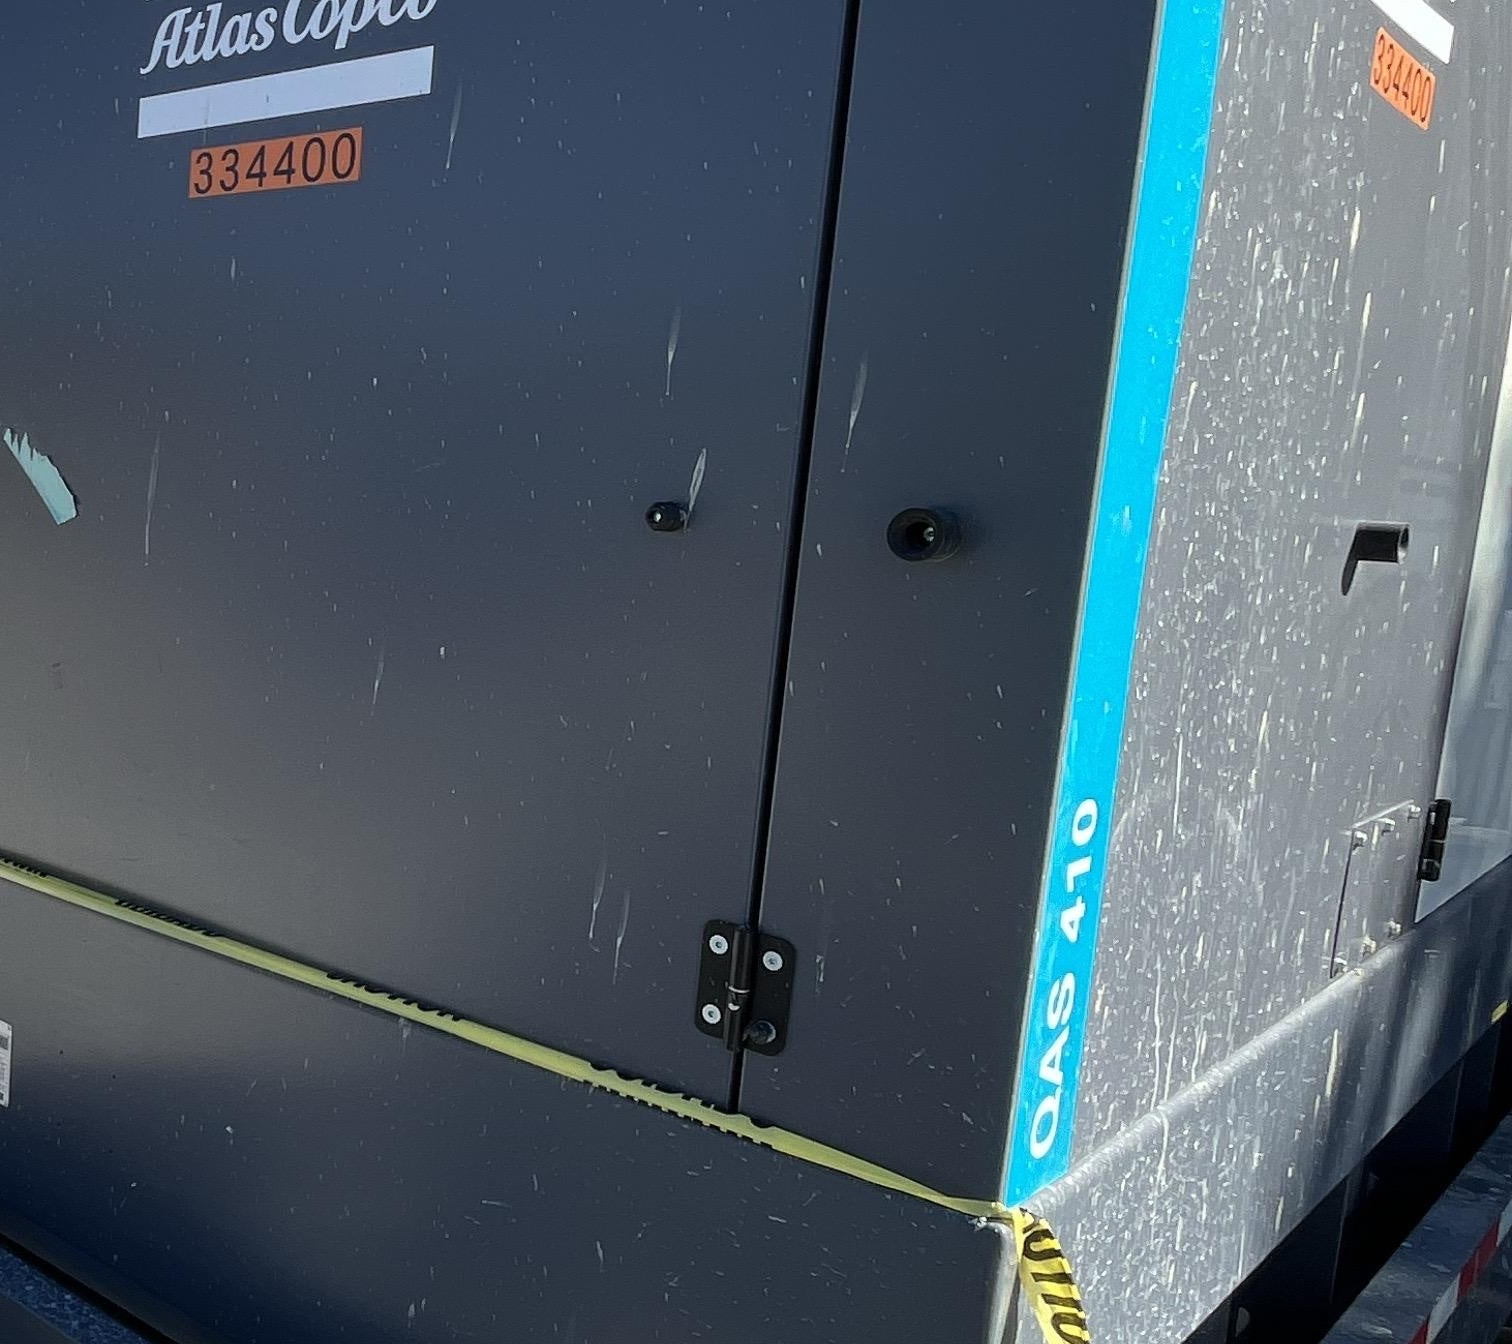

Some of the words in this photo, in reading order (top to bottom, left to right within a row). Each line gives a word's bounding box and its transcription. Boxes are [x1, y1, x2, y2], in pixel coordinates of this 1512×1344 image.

[139, 1, 279, 75] Atlas
[1372, 33, 1432, 124] 334400
[193, 132, 357, 195] 334400
[1029, 971, 1075, 1160] QAS
[1059, 798, 1099, 944] 410
